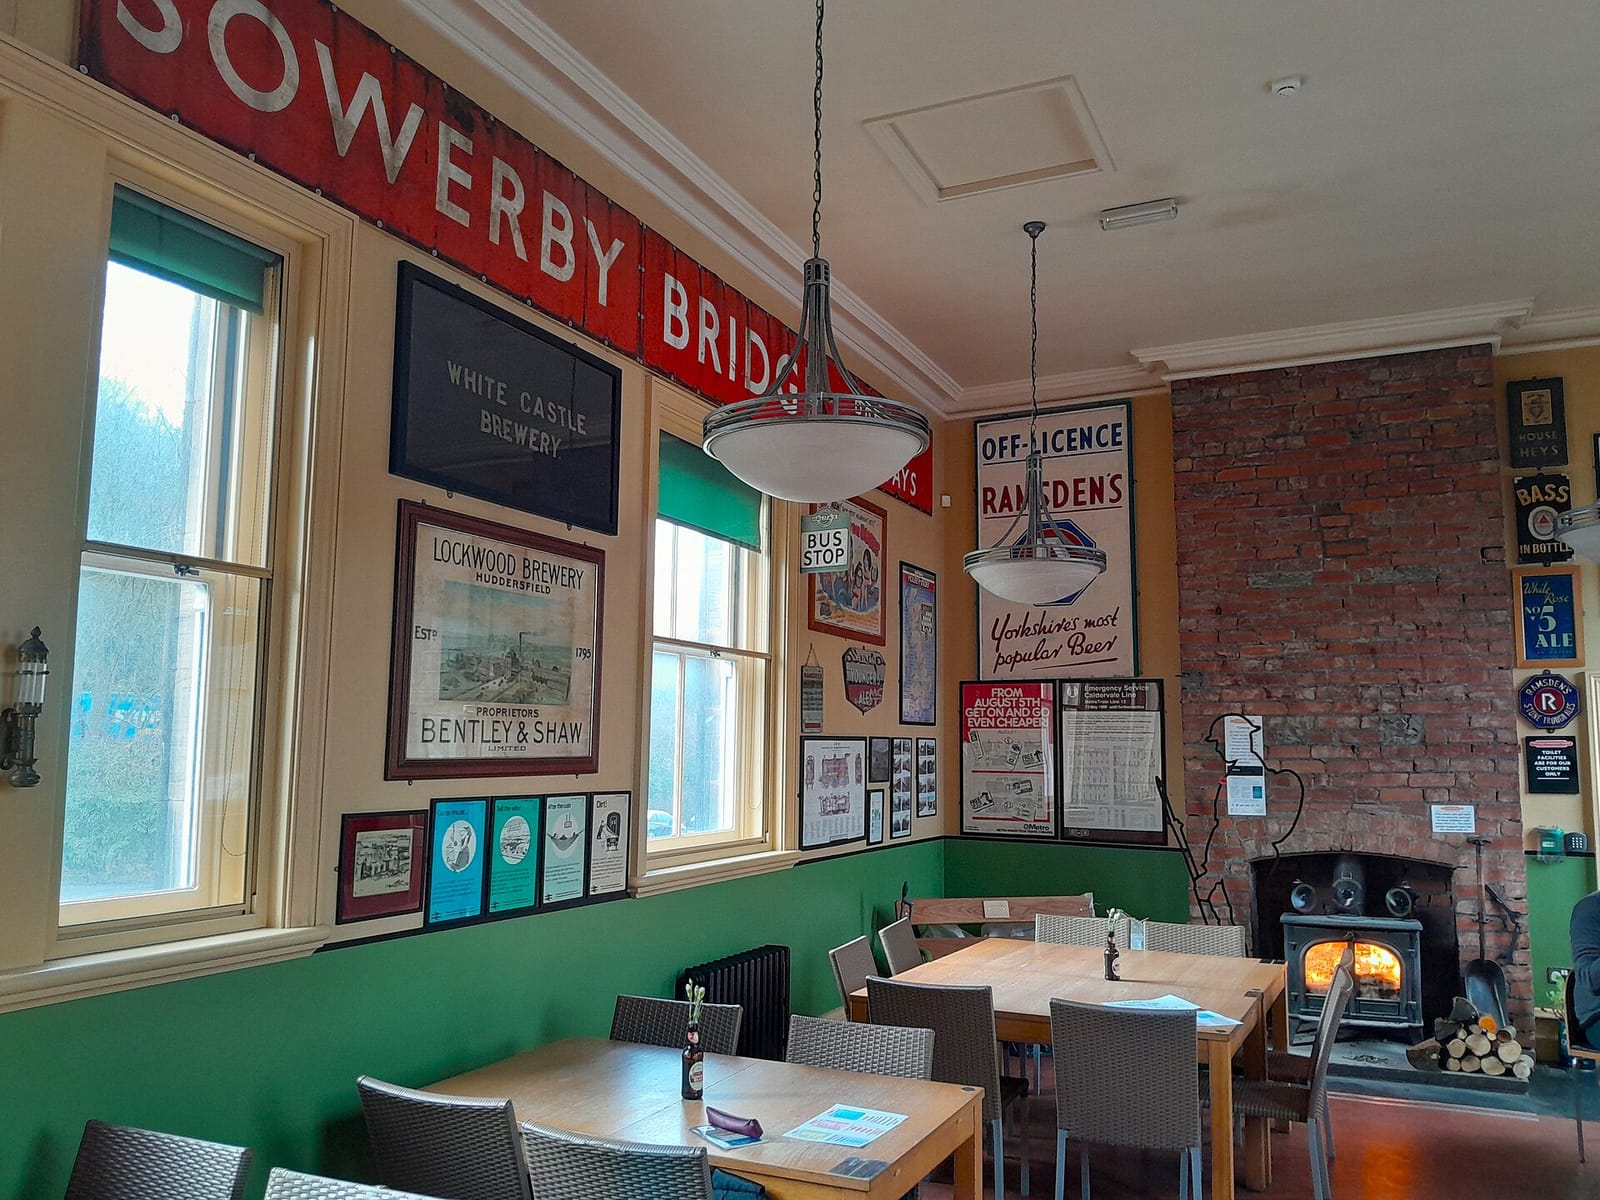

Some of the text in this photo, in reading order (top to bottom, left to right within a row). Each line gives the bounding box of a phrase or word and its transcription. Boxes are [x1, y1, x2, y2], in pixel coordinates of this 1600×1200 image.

[664, 272, 833, 416] BRIDG
[447, 360, 587, 436] WHITE CASTLE
[1520, 445, 1560, 457] HEYS
[1516, 483, 1570, 506] BASS
[807, 531, 842, 549] BUS
[803, 548, 845, 567] STOP
[1519, 544, 1530, 555] IN
[433, 537, 585, 590] LOCKWOOD BREWERY
[476, 572, 551, 595] HUDDERSFIELD
[1523, 581, 1551, 595] White
[1544, 592, 1569, 605] Rose
[1538, 605, 1557, 632] 5
[991, 606, 1120, 653] Yorkshire's most
[1535, 633, 1574, 648] ALE
[575, 647, 592, 661] 1795
[993, 631, 1118, 675] popular Beer
[991, 687, 1024, 698] FROM
[1084, 685, 1122, 693] Emergency
[1525, 678, 1572, 696] RAMSDEN'S
[974, 697, 1041, 708] AUGUST 5TH
[1541, 692, 1557, 711] R
[476, 706, 539, 719] PROPRIETORS
[965, 707, 1050, 718] GET ON AND GO
[967, 717, 1049, 728] EVEN CHEAPER
[421, 718, 583, 744] BENTLEY & SHAW
[1028, 823, 1050, 831] Metro
